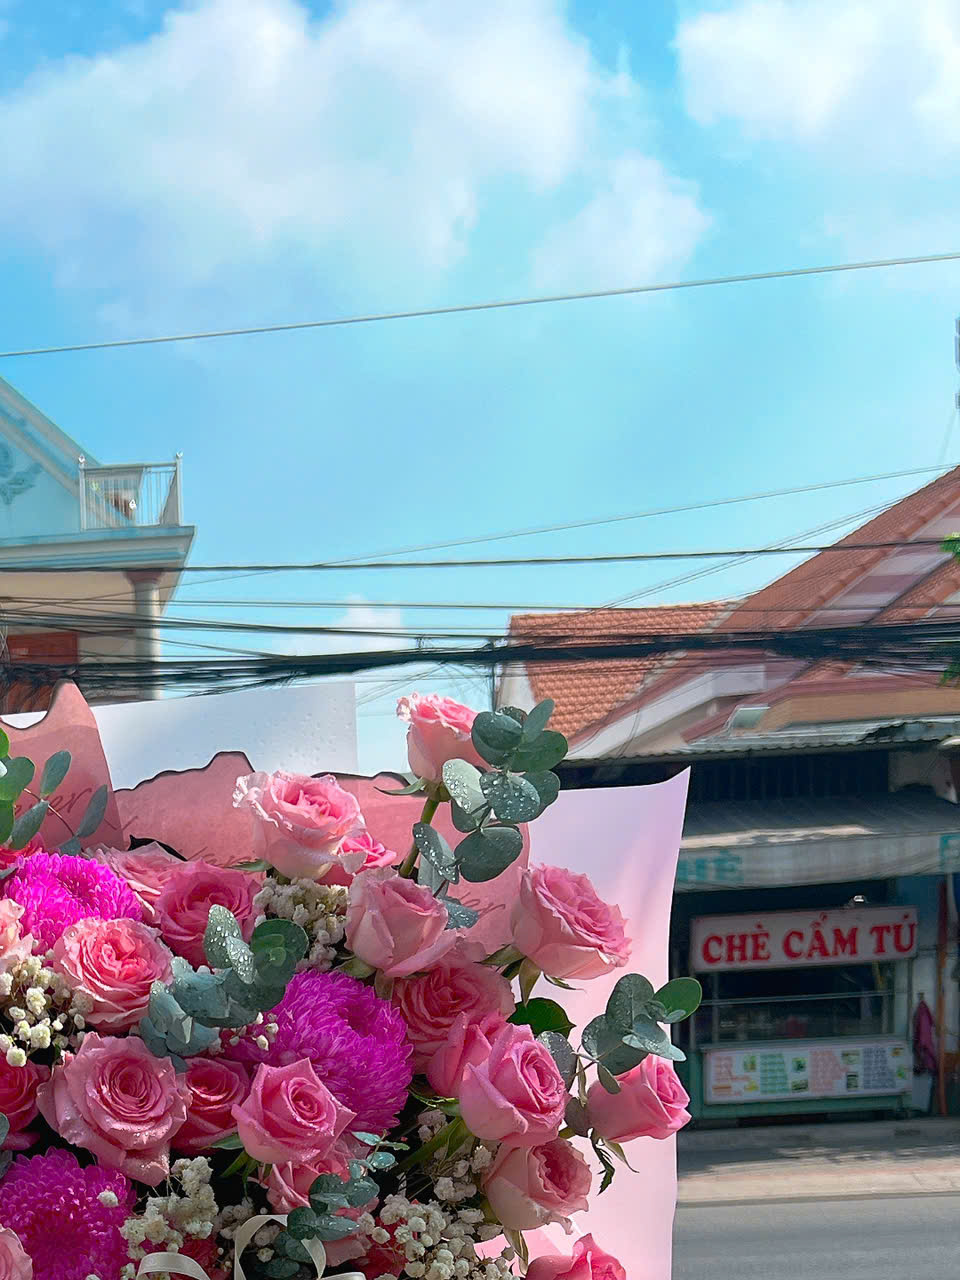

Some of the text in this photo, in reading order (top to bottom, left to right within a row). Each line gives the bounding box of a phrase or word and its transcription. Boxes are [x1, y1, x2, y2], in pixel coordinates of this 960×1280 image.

[702, 912, 918, 964] CHÈ CẨM TÚ
